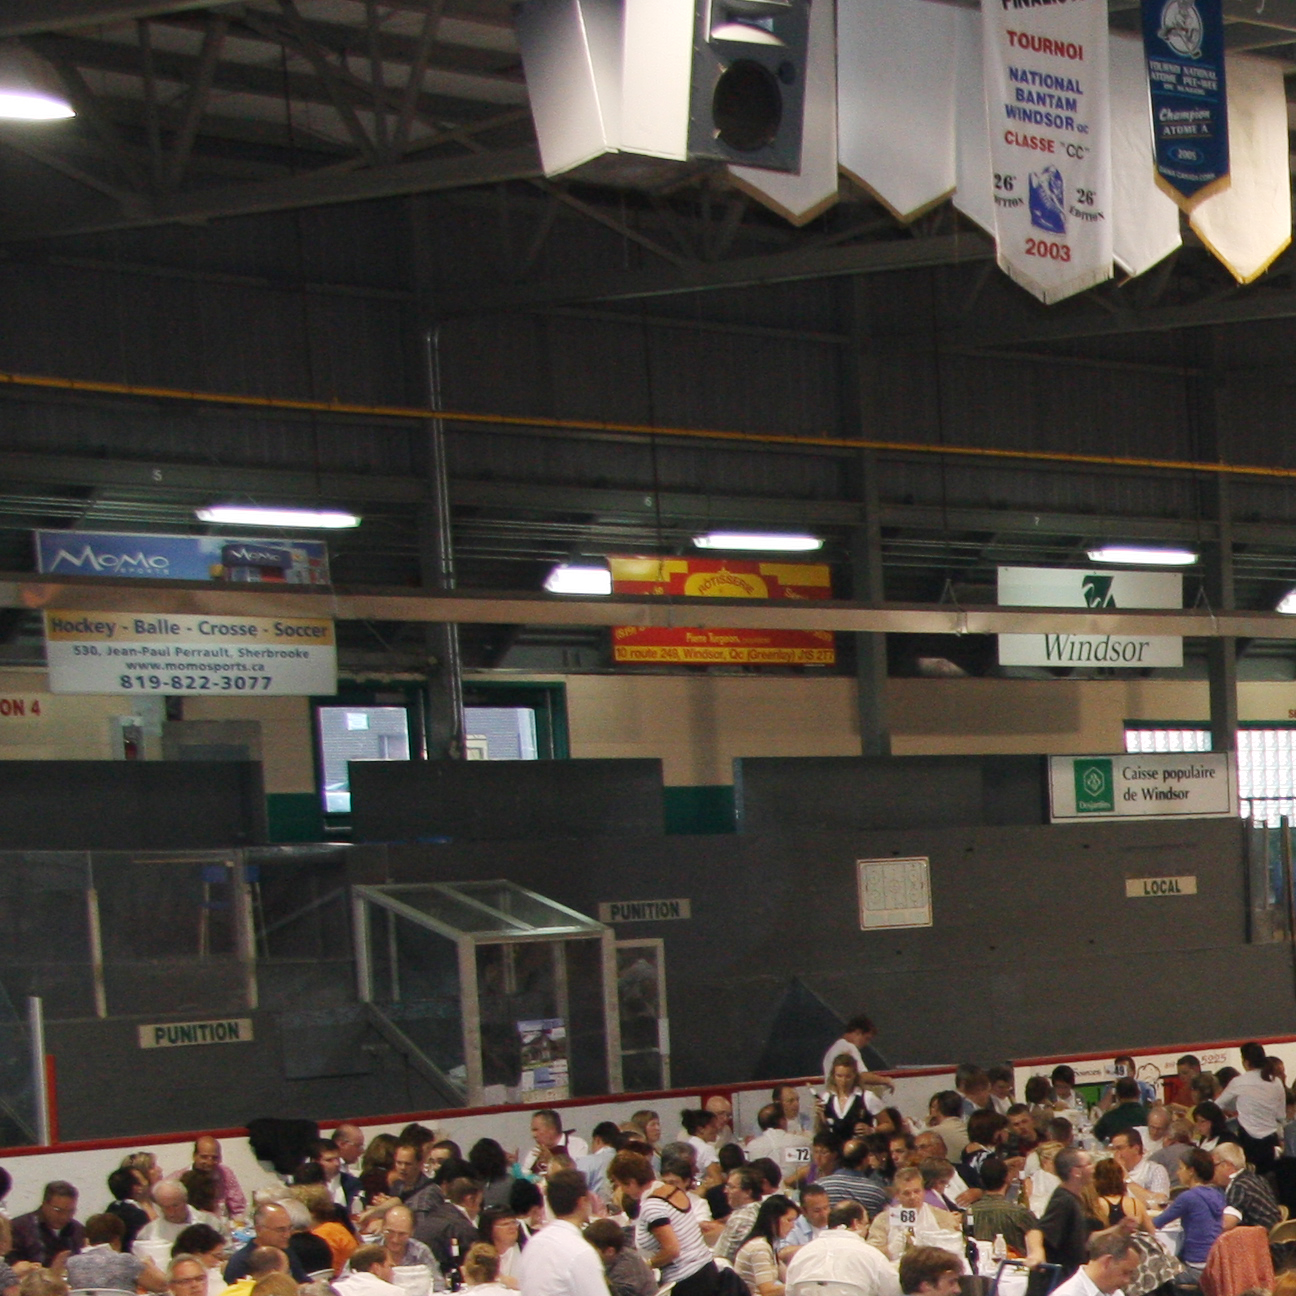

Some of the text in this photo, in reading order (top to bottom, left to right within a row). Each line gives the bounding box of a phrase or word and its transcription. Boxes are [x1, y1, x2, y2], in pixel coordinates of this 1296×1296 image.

[1006, 30, 1084, 61] TOURNOI
[1008, 66, 1084, 95] NATIONAL
[1151, 71, 1177, 84] ATOME
[1183, 75, 1218, 91] PEE-WEE
[1015, 86, 1078, 113] BANTAM
[1004, 103, 1075, 132] WINDSOR
[1159, 107, 1211, 124] Champion
[1163, 124, 1209, 136] ATOME A
[1004, 130, 1055, 154] CLASSE
[1025, 238, 1071, 262] 2003
[51, 616, 115, 637] Hockey
[134, 619, 180, 636] Balle
[198, 620, 258, 637] Crosse
[274, 622, 328, 638] Soccer
[686, 631, 707, 643] Pierre
[106, 645, 171, 658] Jean-Paul
[238, 647, 310, 660] Sherbrooke
[629, 648, 659, 660] route
[683, 648, 727, 662] Windsor,
[729, 649, 744, 660] Qc
[1044, 633, 1150, 662] Windsor
[126, 661, 266, 674] www.momosports.ca
[120, 675, 274, 691] 819-822-3077
[1122, 765, 1216, 783] Caisse populaire
[1123, 787, 1190, 801] de Windsor
[1144, 879, 1181, 895] LOCAL
[610, 901, 680, 921] PUNITION
[154, 1022, 240, 1045] PUNITION
[796, 1148, 810, 1161] 72
[900, 1210, 916, 1223] 68
